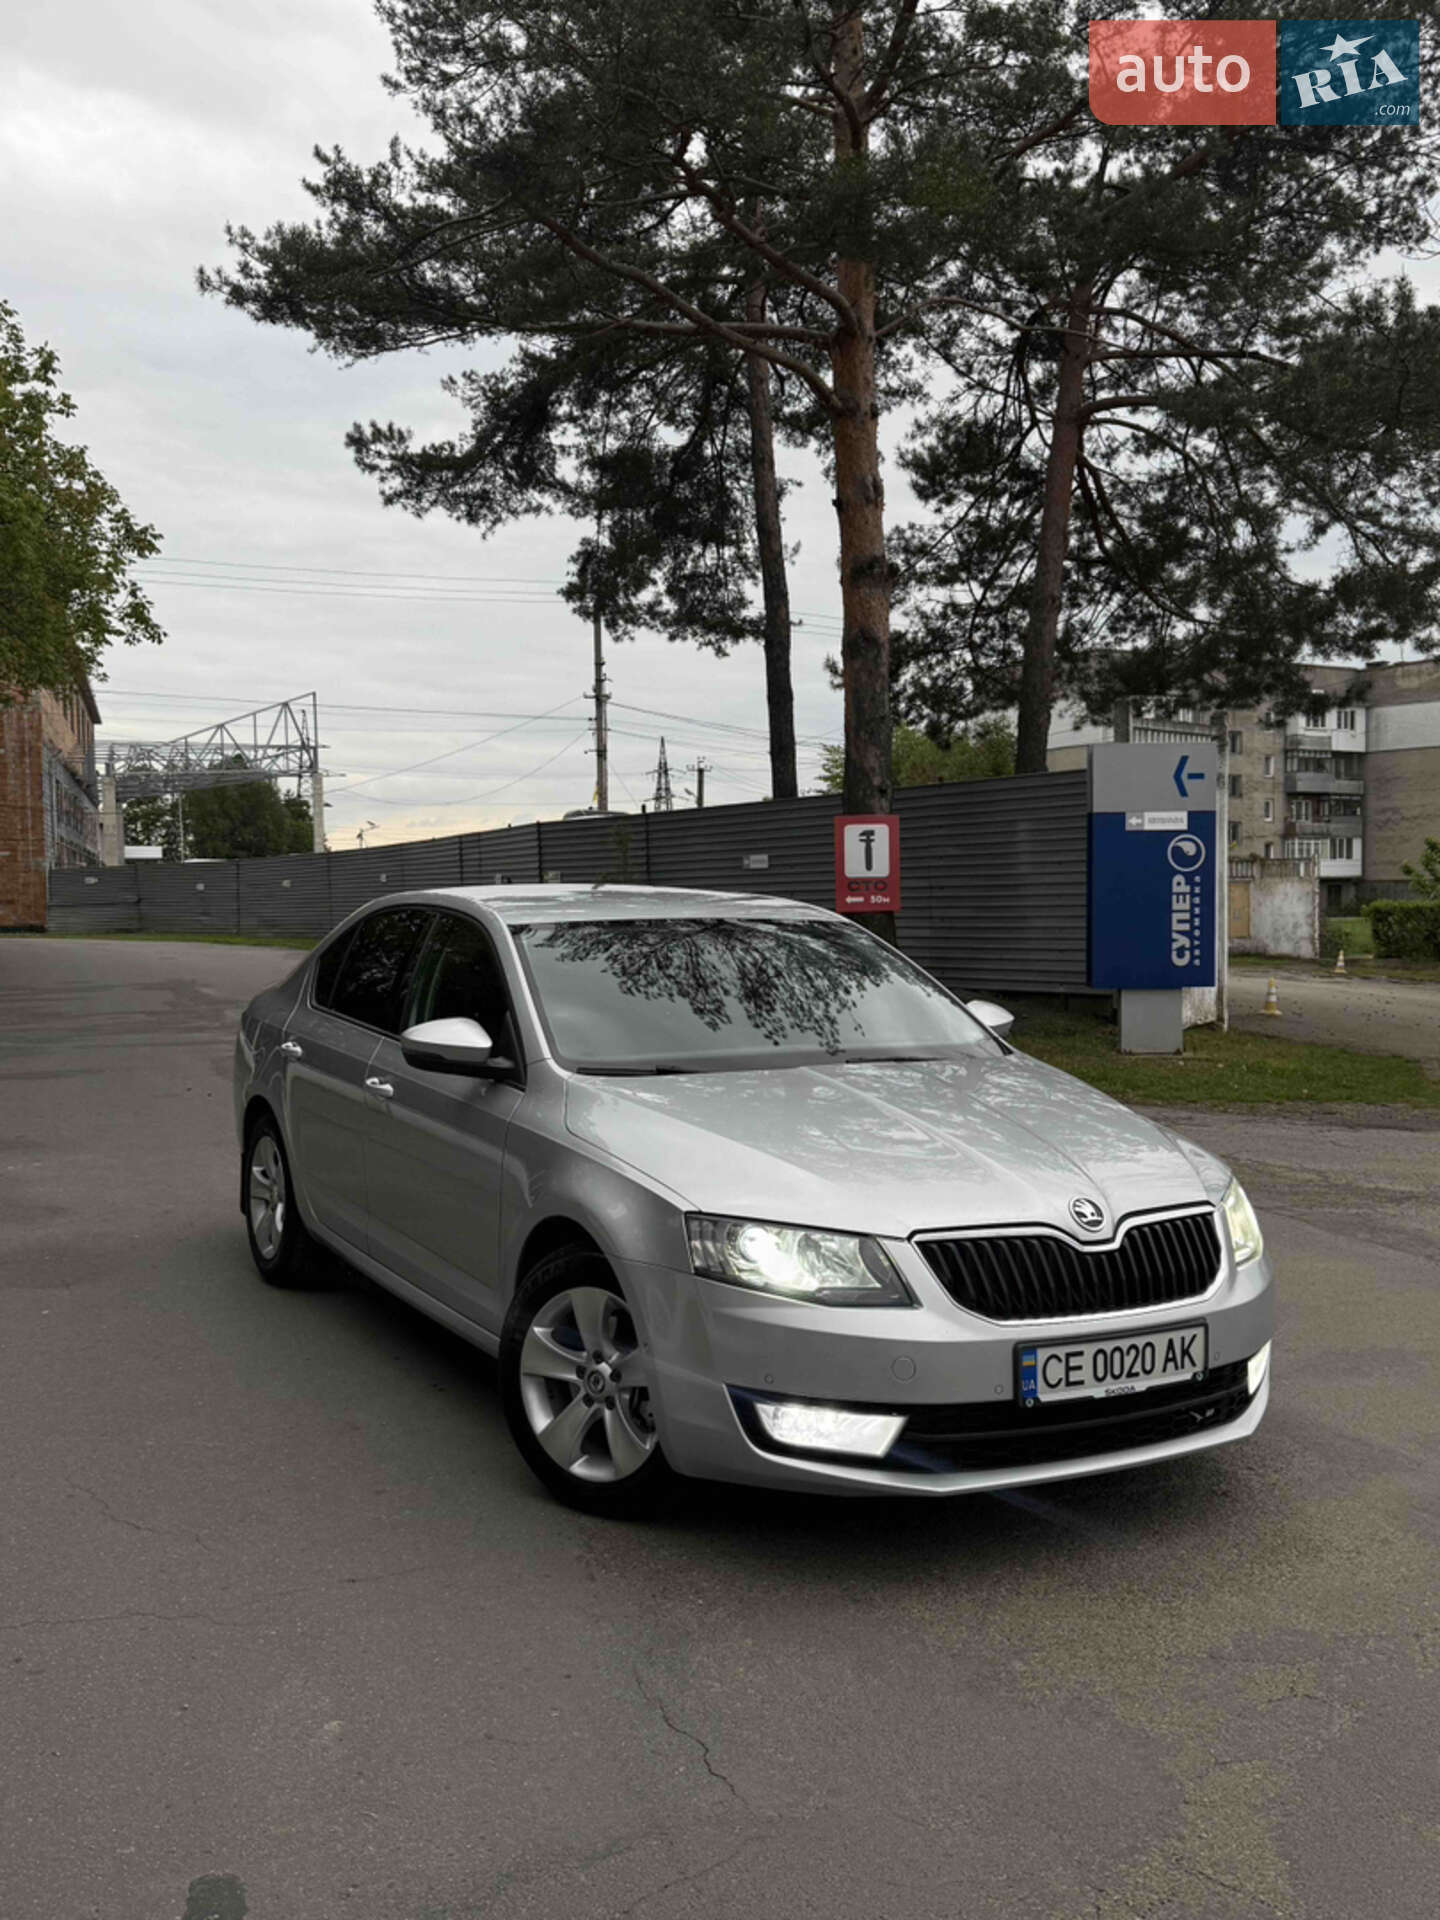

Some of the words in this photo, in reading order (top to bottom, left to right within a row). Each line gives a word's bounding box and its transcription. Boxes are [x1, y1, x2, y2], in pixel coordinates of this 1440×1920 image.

[847, 880, 888, 892] СТО
[1171, 874, 1191, 966] СУПЕР
[1042, 1351, 1085, 1389] CE
[1093, 1342, 1156, 1382] 0020
[1162, 1333, 1198, 1373] AK
[1022, 1379, 1036, 1391] UA
